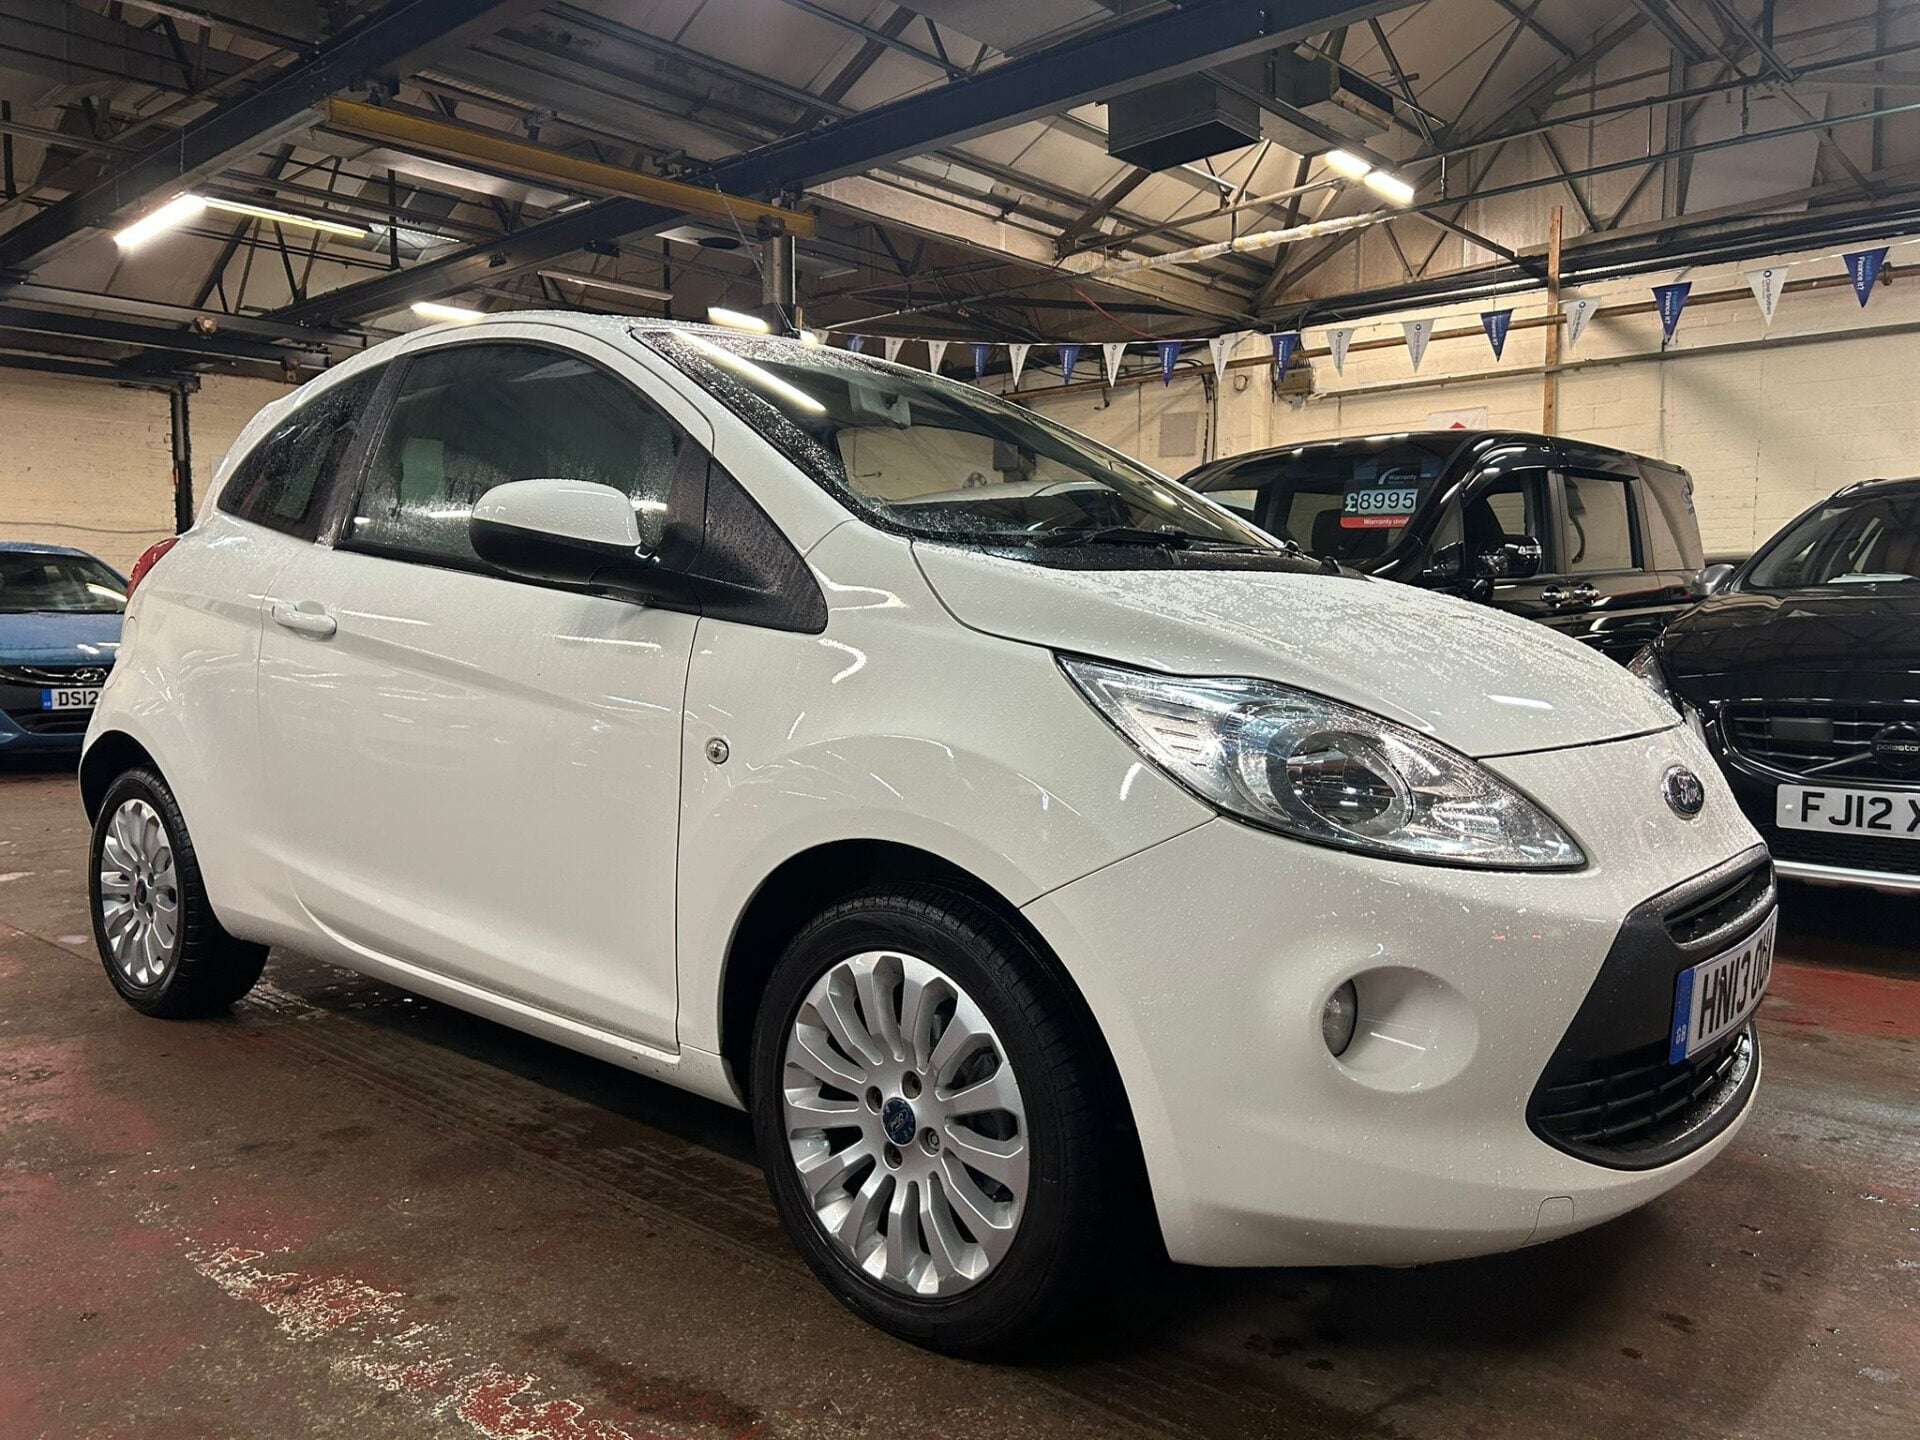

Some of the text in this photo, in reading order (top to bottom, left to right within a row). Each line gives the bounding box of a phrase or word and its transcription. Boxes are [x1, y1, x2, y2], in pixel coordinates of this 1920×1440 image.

[1344, 491, 1415, 512] £8995
[58, 690, 99, 706] DS12
[1801, 791, 1893, 831] FJ12
[1698, 950, 1751, 1040] HN13
